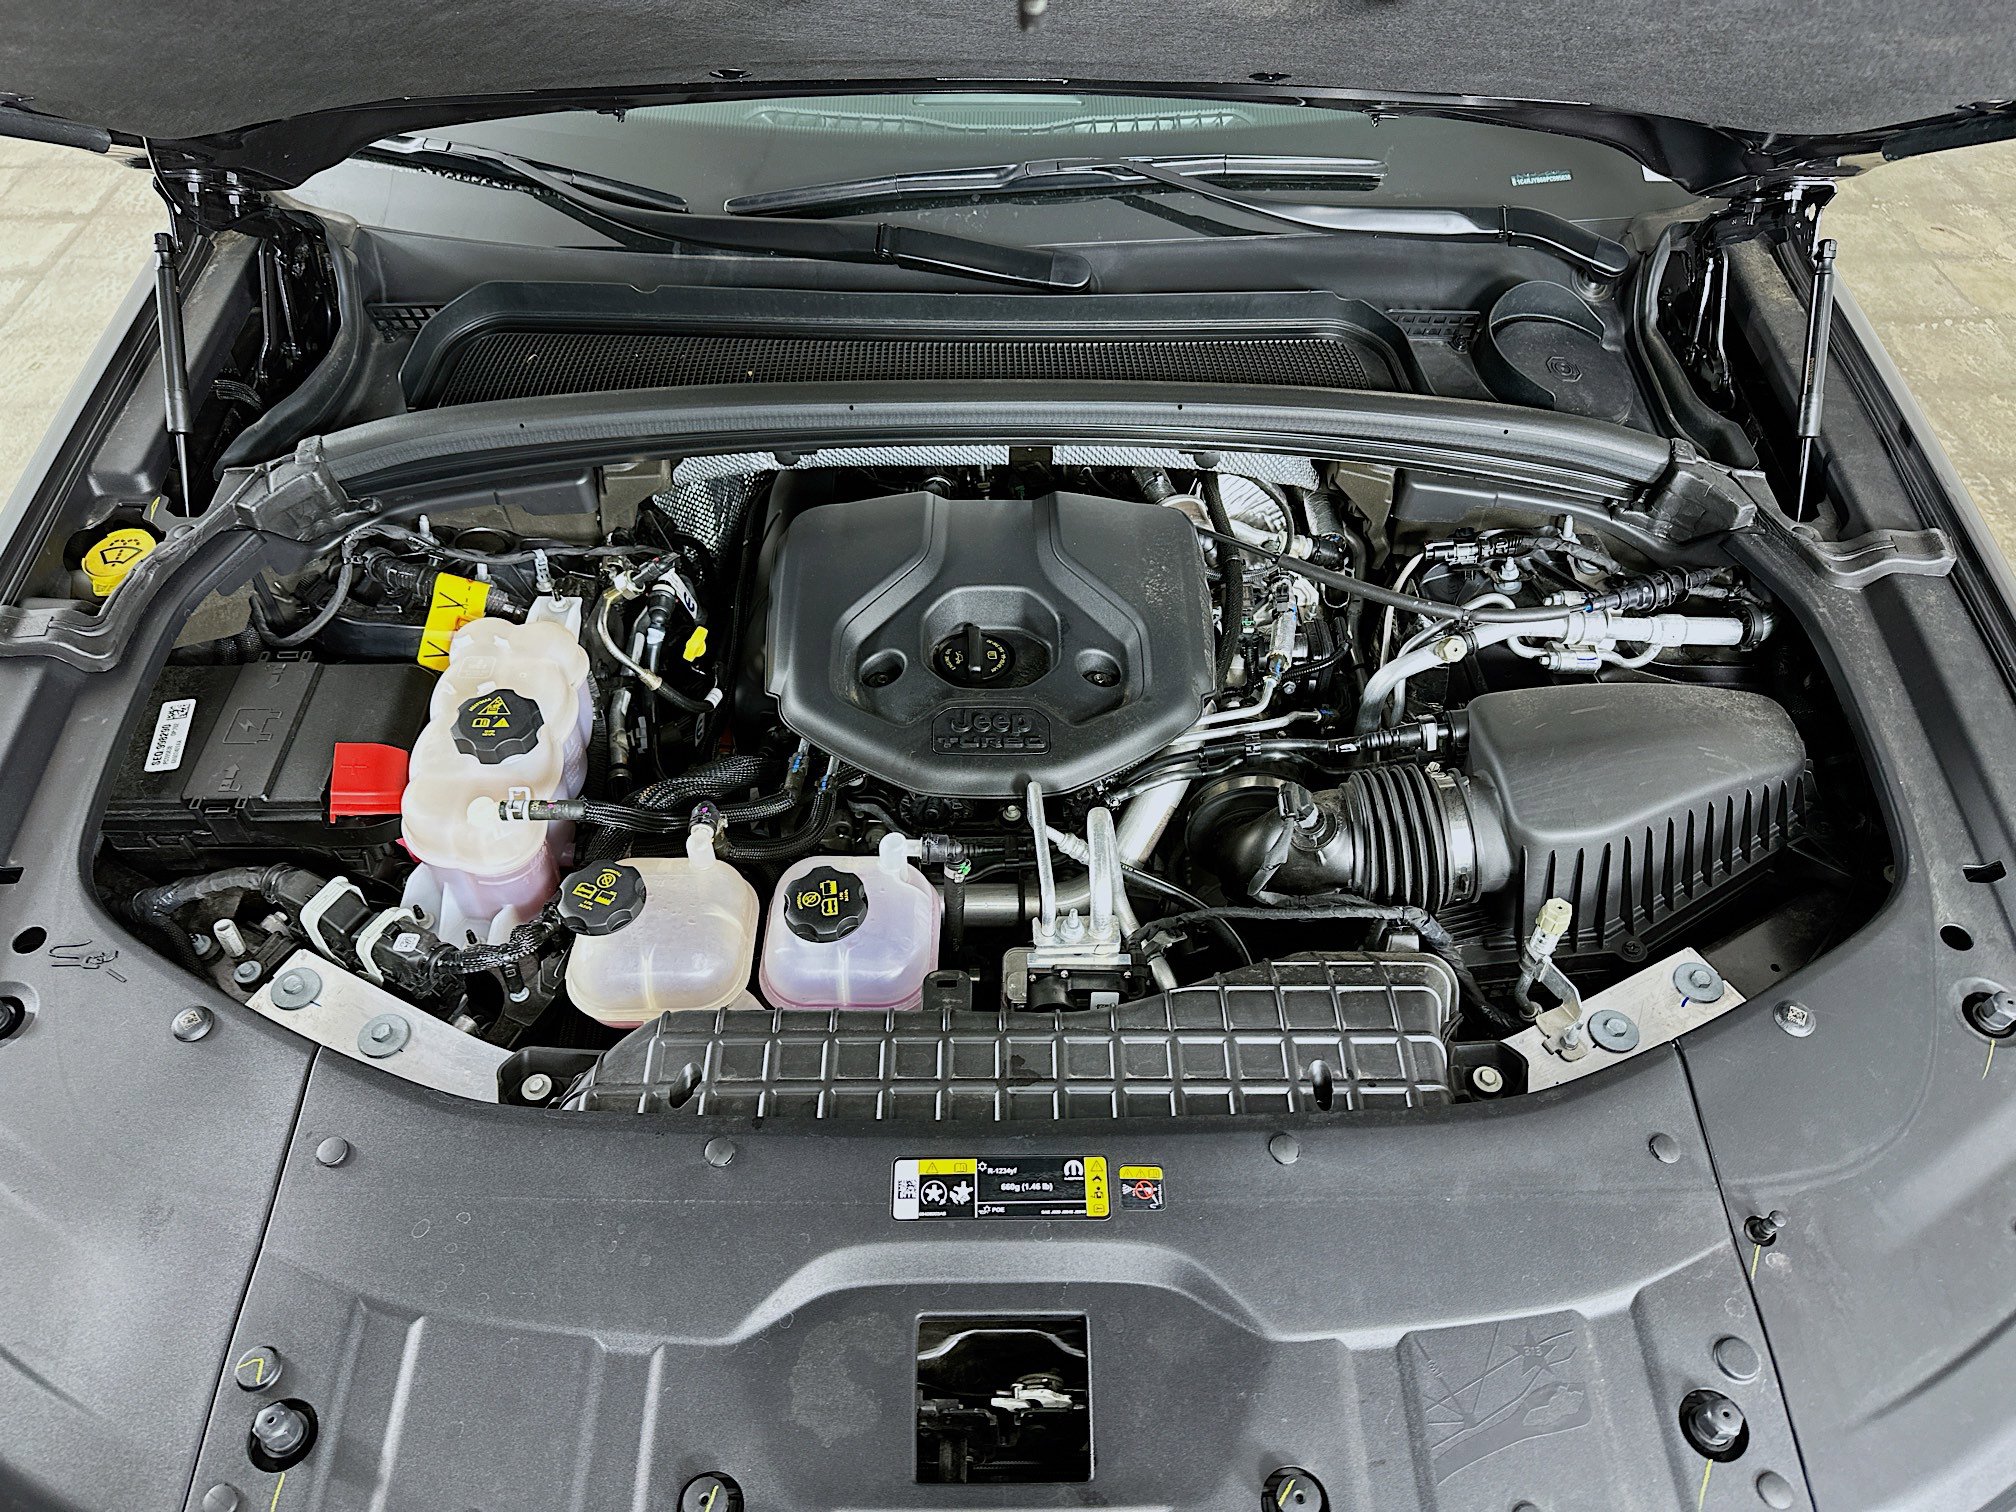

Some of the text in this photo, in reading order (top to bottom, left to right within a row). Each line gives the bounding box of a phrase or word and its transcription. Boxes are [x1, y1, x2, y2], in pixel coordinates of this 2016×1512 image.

[951, 708, 1032, 737] Jeep
[937, 736, 1046, 749] TURBO
[987, 1166, 1018, 1176] R-1234yf
[1041, 1182, 1054, 1192] lb)
